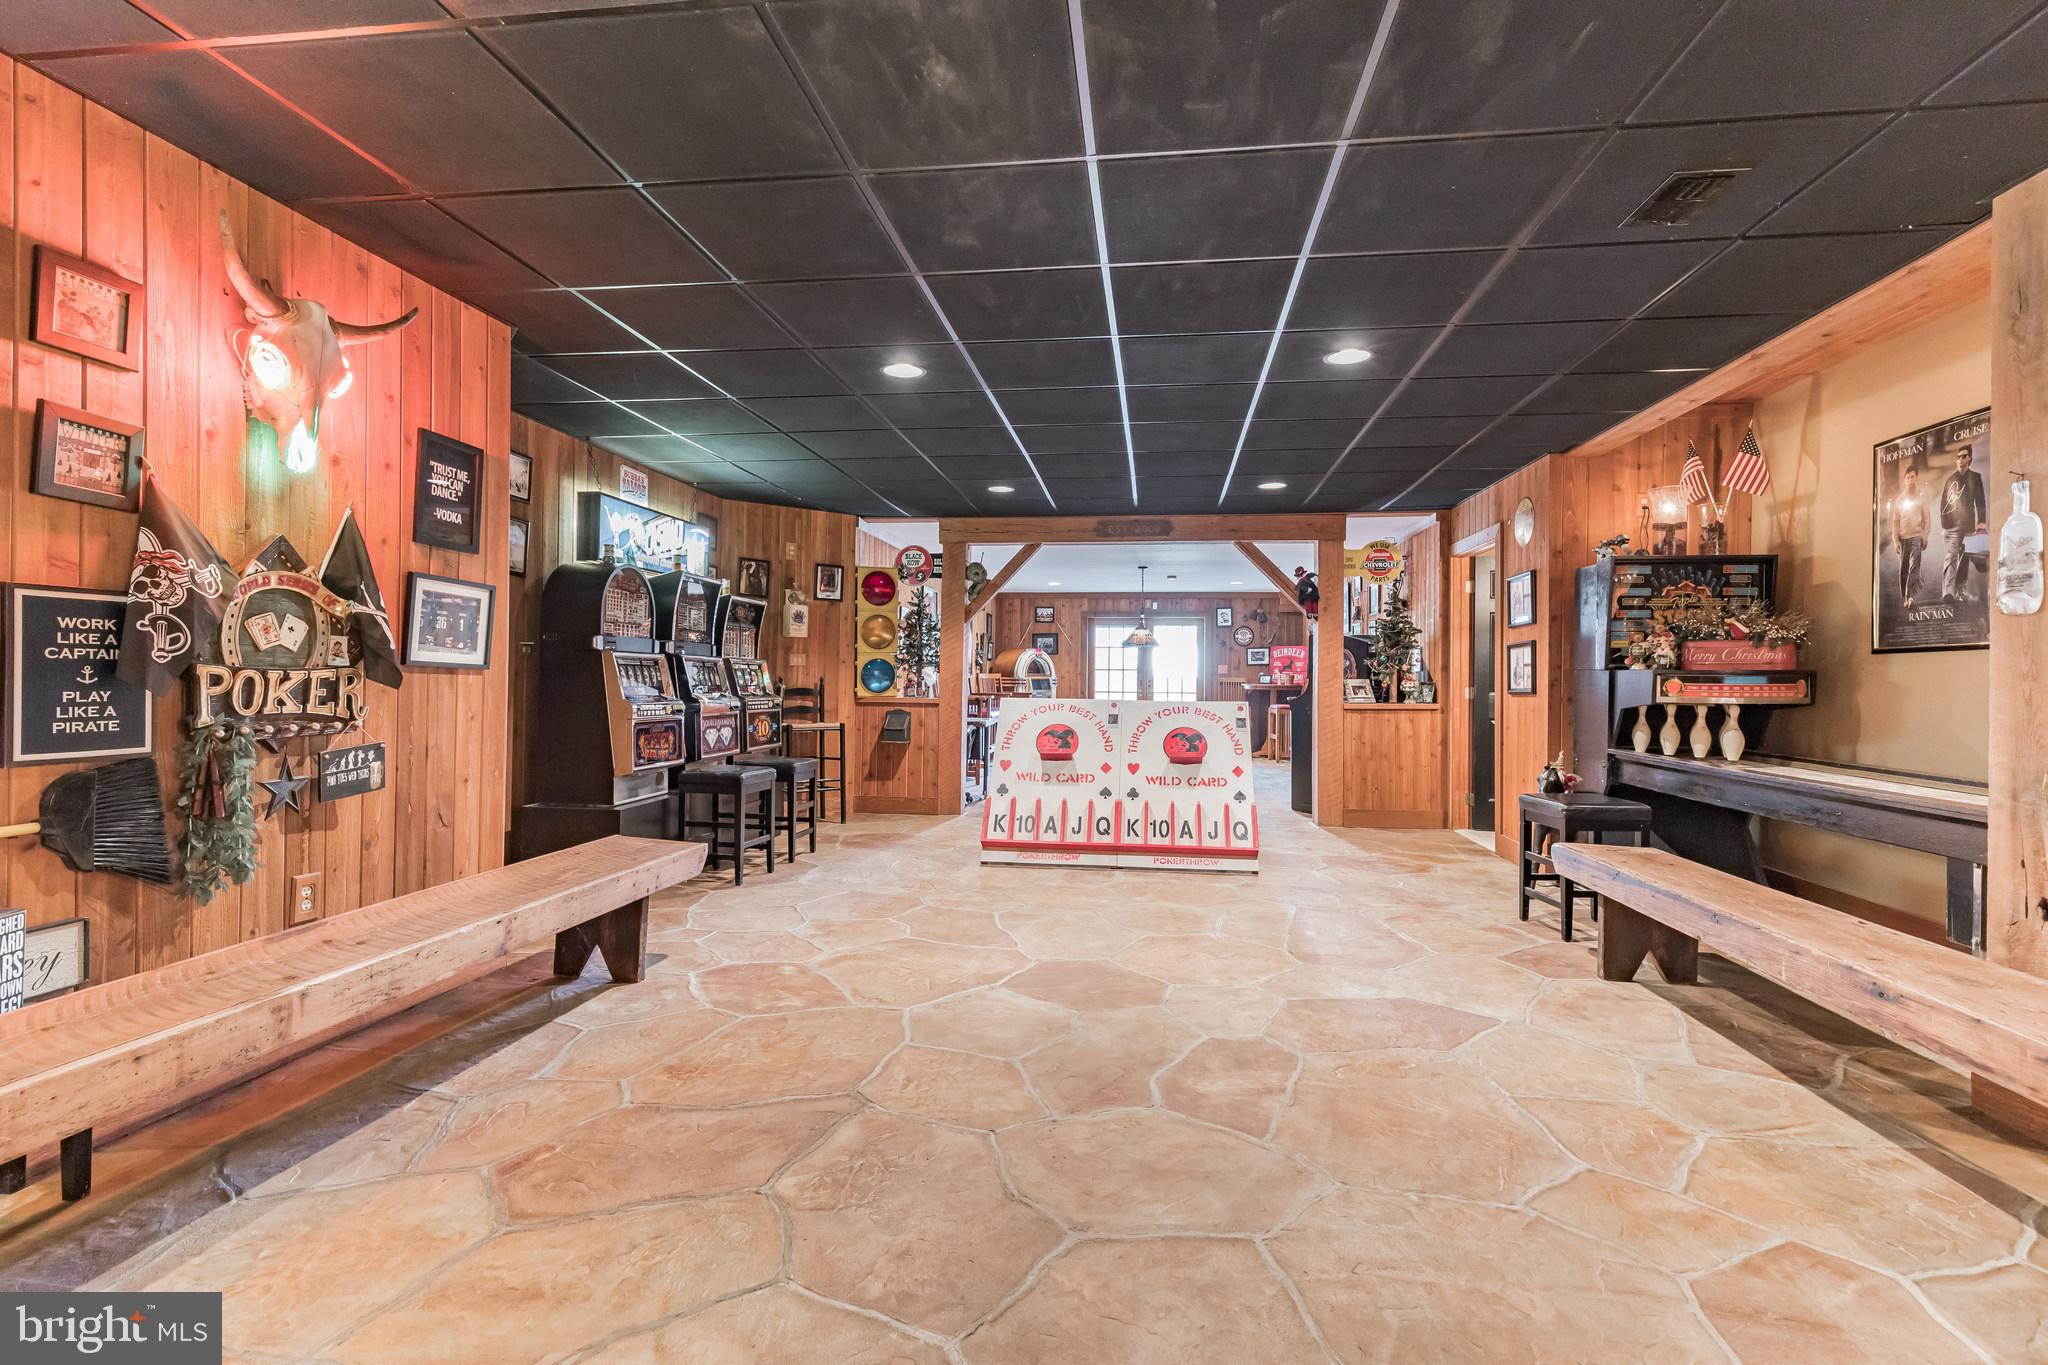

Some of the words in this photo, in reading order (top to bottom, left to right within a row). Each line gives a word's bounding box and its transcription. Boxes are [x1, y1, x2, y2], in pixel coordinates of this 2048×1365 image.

[61, 425, 120, 450] WINTER
[1953, 422, 1989, 442] CRUISE
[1881, 443, 1924, 464] HOFFMAN
[449, 479, 463, 492] CAN
[434, 508, 462, 524] -VODKA
[1363, 561, 1396, 569] CHEVROLET
[1370, 575, 1390, 583] PARTS
[1908, 610, 1931, 622] RAIN
[1932, 608, 1954, 620] MAN
[57, 616, 117, 631] WORK
[57, 632, 100, 645] LIKE
[105, 634, 118, 646] A
[1273, 647, 1306, 659] REINDEER
[1682, 647, 1717, 662] Merry
[1721, 647, 1787, 661] Christmas
[62, 690, 111, 703] PLAY
[196, 664, 369, 728] POKER
[56, 706, 100, 719] LIKE
[103, 705, 116, 717] A
[52, 720, 120, 734] PIRATE
[757, 720, 769, 737] 10
[1002, 714, 1028, 751] THROW
[1031, 703, 1065, 716] YOUR
[1068, 704, 1097, 721] BEST
[1094, 720, 1114, 753] HAND
[1128, 716, 1153, 754] THROW
[1154, 706, 1190, 719] YOUR
[1194, 707, 1224, 724] BEST
[1222, 723, 1244, 756] HAND
[1016, 772, 1051, 783] WILD
[1056, 773, 1096, 783] CARD
[1145, 775, 1182, 786] WILD
[1187, 776, 1228, 787] CARD
[993, 814, 1007, 833] K
[1016, 815, 1035, 833] 10
[1043, 815, 1057, 834] A
[1071, 816, 1082, 835] J
[1095, 816, 1111, 836] Q
[1126, 818, 1140, 838] K
[1149, 819, 1170, 838] 10
[1179, 820, 1194, 839] A
[1208, 820, 1219, 840] J
[1233, 820, 1249, 841] Q
[1016, 852, 1081, 861] POKERTHROW
[1153, 857, 1220, 866] POKERTHROW
